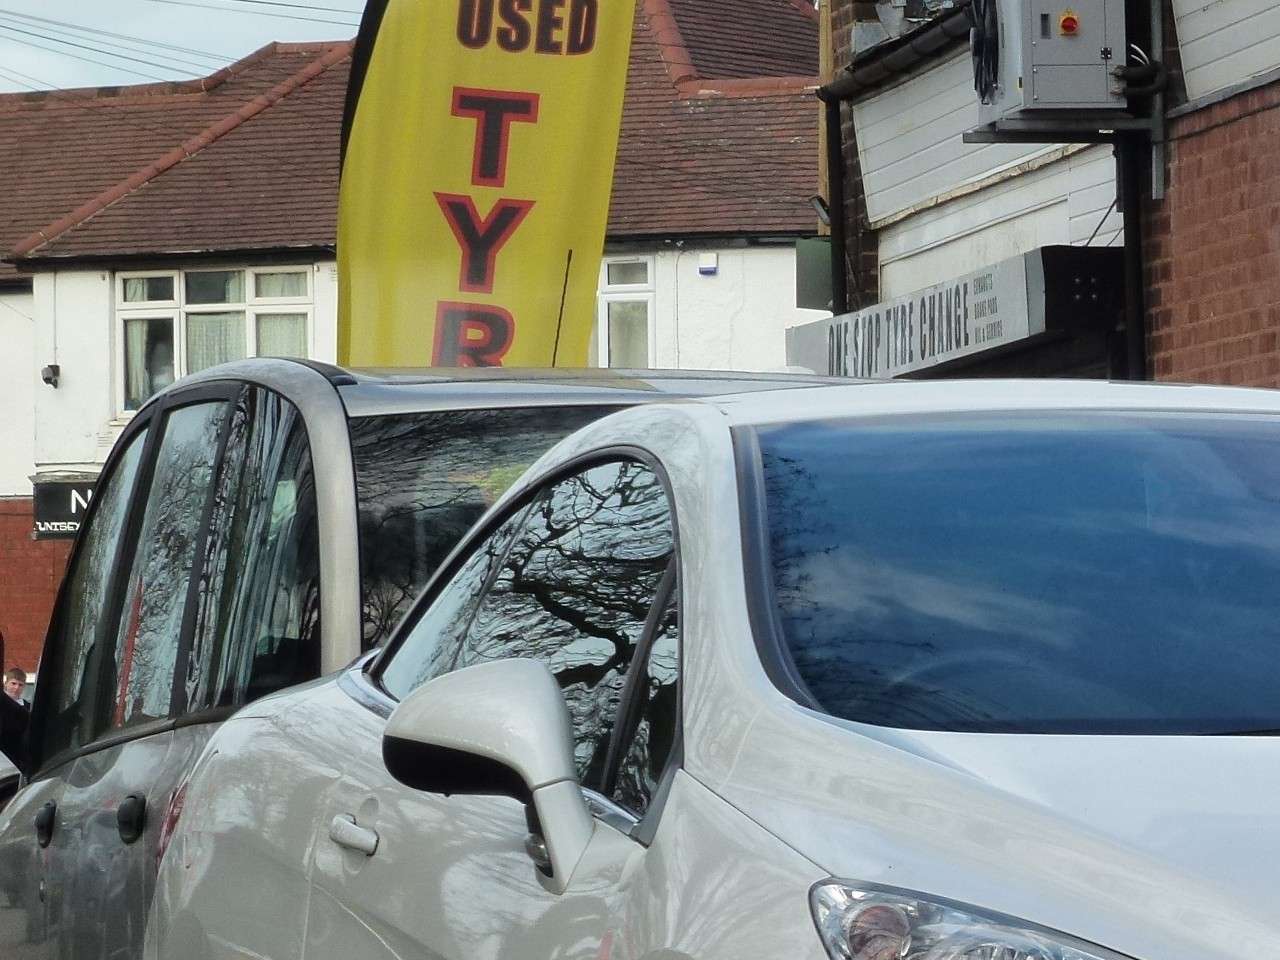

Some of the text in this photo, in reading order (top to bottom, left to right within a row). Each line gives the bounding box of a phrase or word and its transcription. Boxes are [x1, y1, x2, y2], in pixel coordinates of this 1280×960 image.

[456, 0, 598, 56] USED
[854, 313, 881, 377] STOP
[886, 301, 913, 369] TYRE
[920, 283, 969, 361] CHANGE
